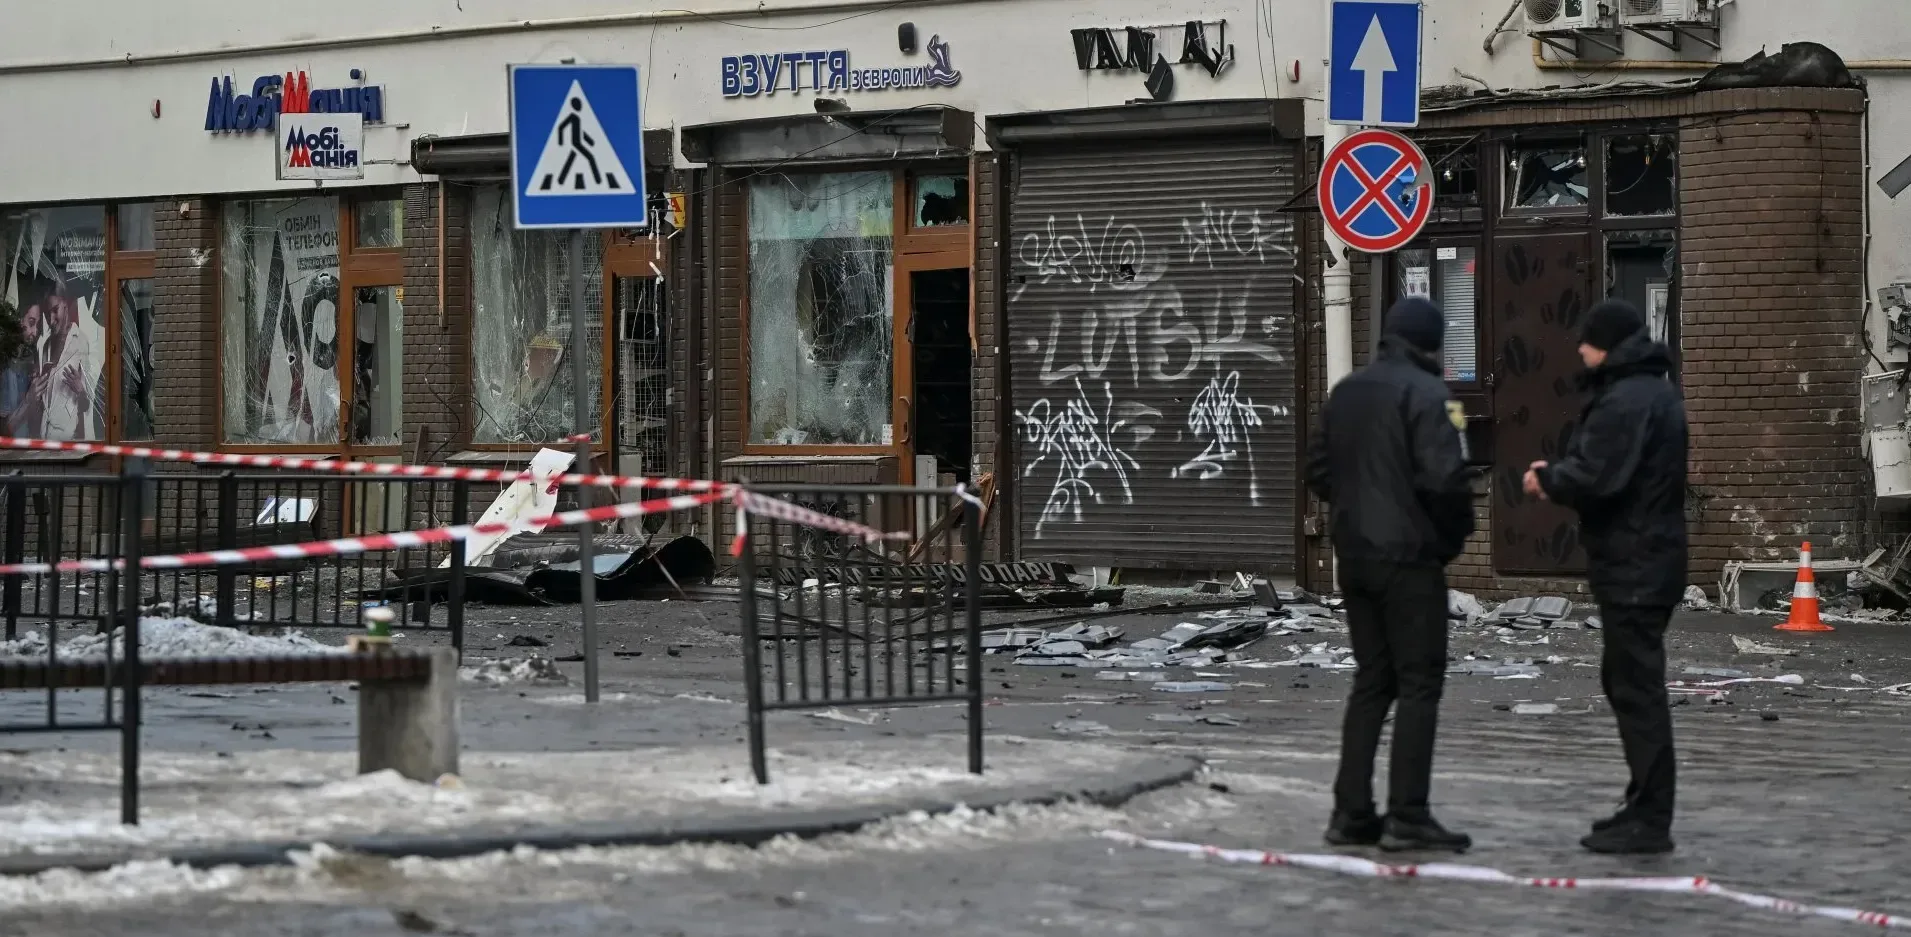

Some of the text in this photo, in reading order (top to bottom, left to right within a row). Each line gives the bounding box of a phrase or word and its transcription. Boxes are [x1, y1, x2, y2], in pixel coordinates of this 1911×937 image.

[721, 49, 849, 97] ВЗУТТЯ
[286, 125, 339, 150] Мобі
[289, 143, 358, 168] Манія
[284, 214, 321, 233] ОБМІН
[995, 562, 1056, 582] ПАРУ
